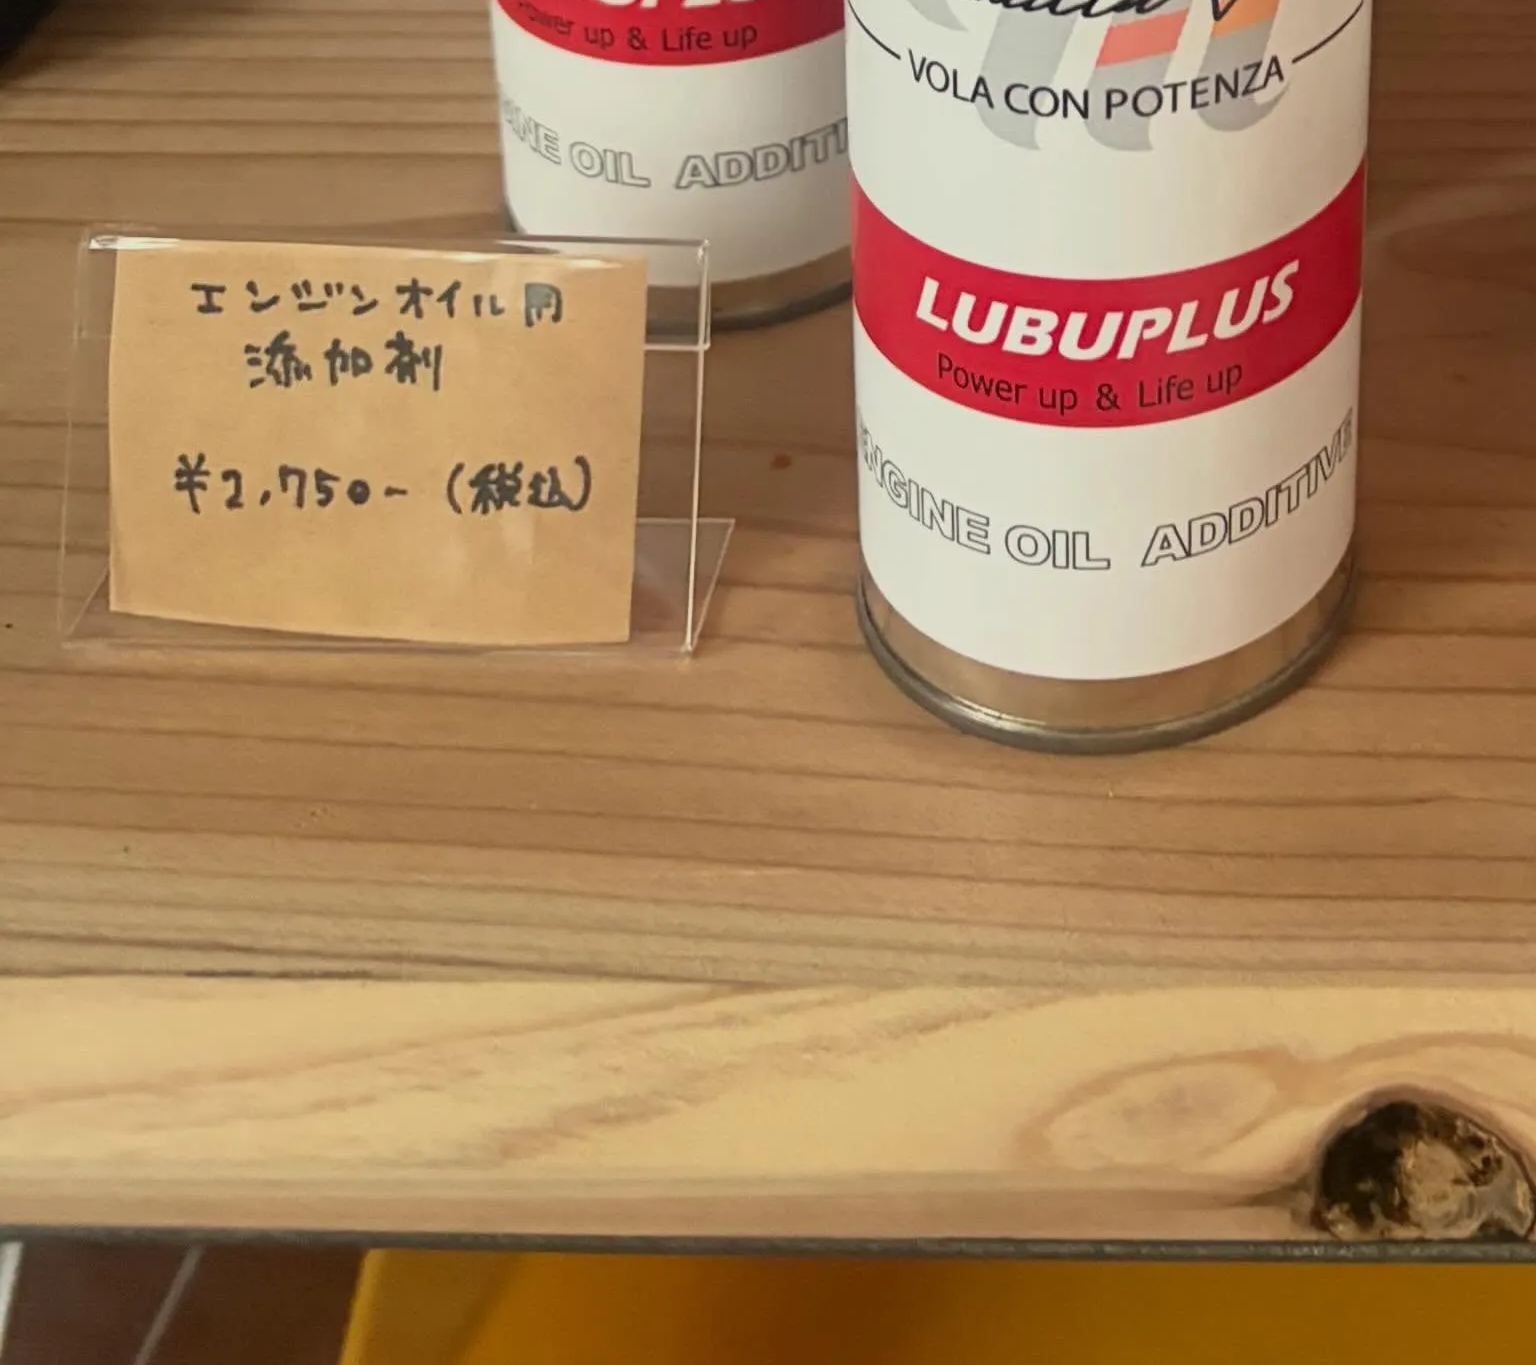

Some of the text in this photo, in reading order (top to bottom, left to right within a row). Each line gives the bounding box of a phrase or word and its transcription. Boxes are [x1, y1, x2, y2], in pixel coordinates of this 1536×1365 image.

[584, 26, 615, 50] up
[627, 28, 648, 51] &
[661, 26, 712, 52] Life
[723, 24, 758, 50] up
[908, 48, 1285, 120] VOLA CON POTENZA
[570, 140, 652, 189] OIL
[673, 116, 848, 190] ADDITI
[915, 259, 1300, 361] LUBUPLUS
[937, 352, 1243, 416] Power up & Life up
[1004, 525, 1111, 571] OIL
